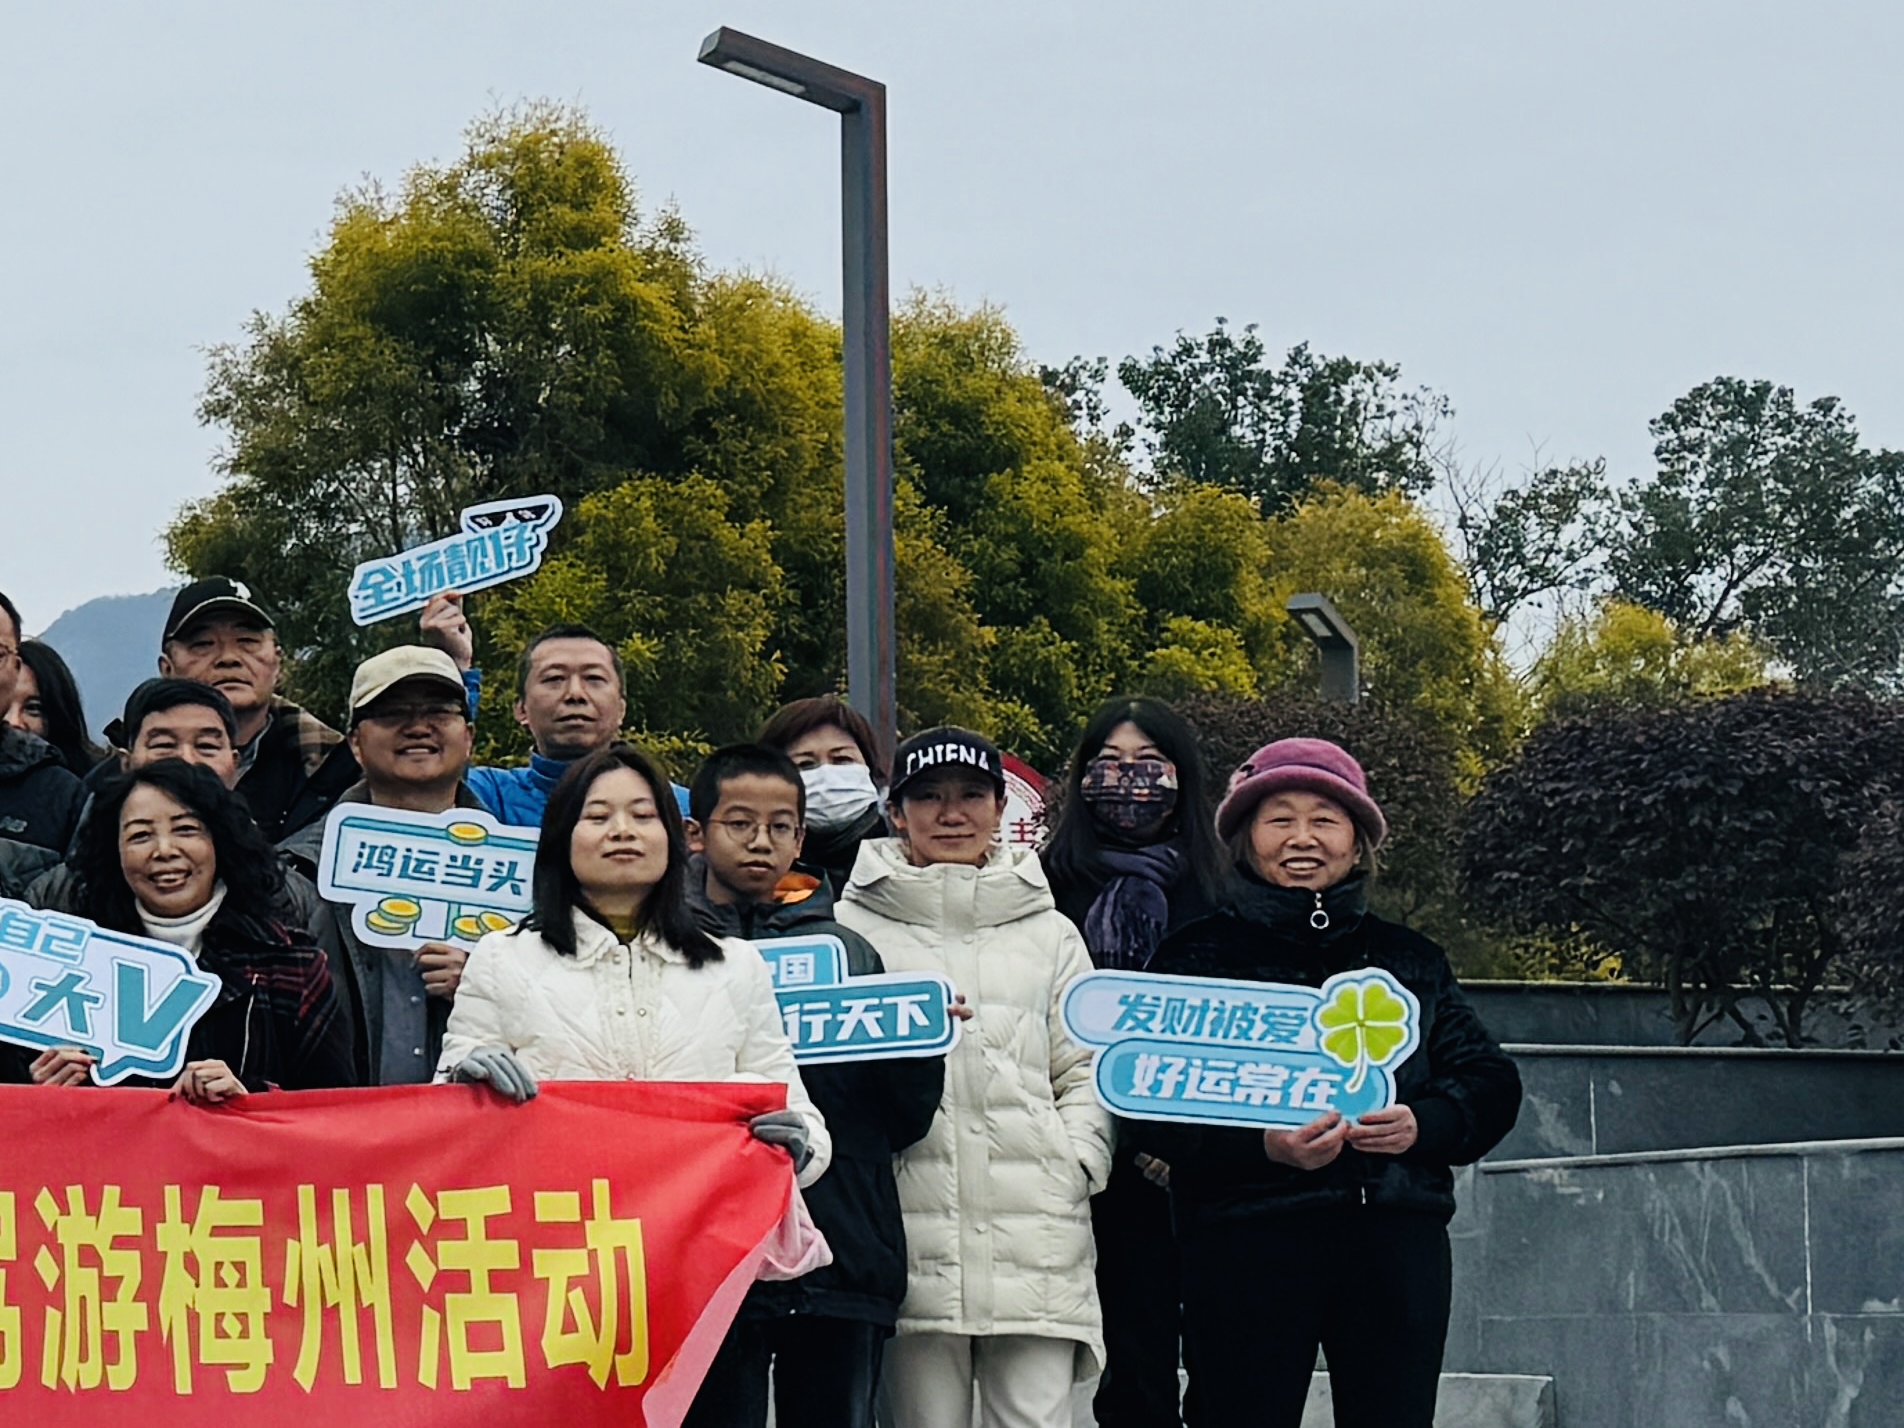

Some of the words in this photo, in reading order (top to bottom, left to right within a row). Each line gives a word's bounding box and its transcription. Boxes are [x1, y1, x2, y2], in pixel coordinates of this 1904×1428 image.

[358, 522, 533, 612] 全场靓仔
[352, 841, 527, 896] 鸿运当头
[1112, 993, 1309, 1044] 发财被爱
[1128, 1054, 1343, 1110] 好运常在
